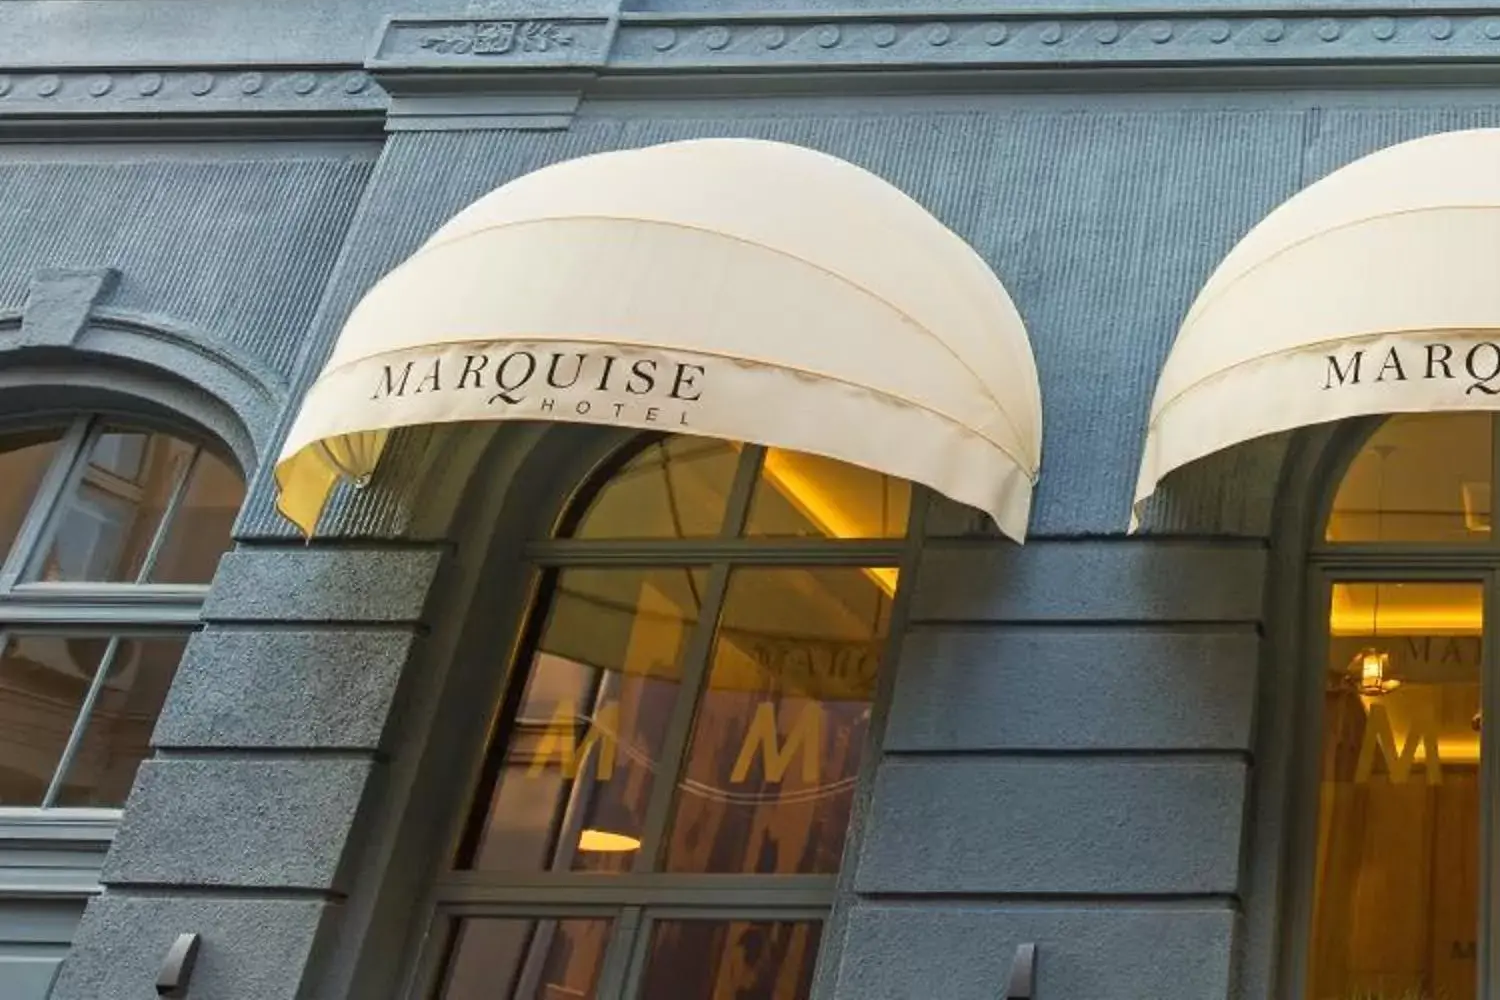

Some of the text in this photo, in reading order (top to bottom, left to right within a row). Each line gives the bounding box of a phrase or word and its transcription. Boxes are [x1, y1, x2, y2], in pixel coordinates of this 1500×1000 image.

[370, 351, 705, 405] MARQUISE
[540, 398, 690, 426] HOTEL
[730, 701, 824, 783] M
